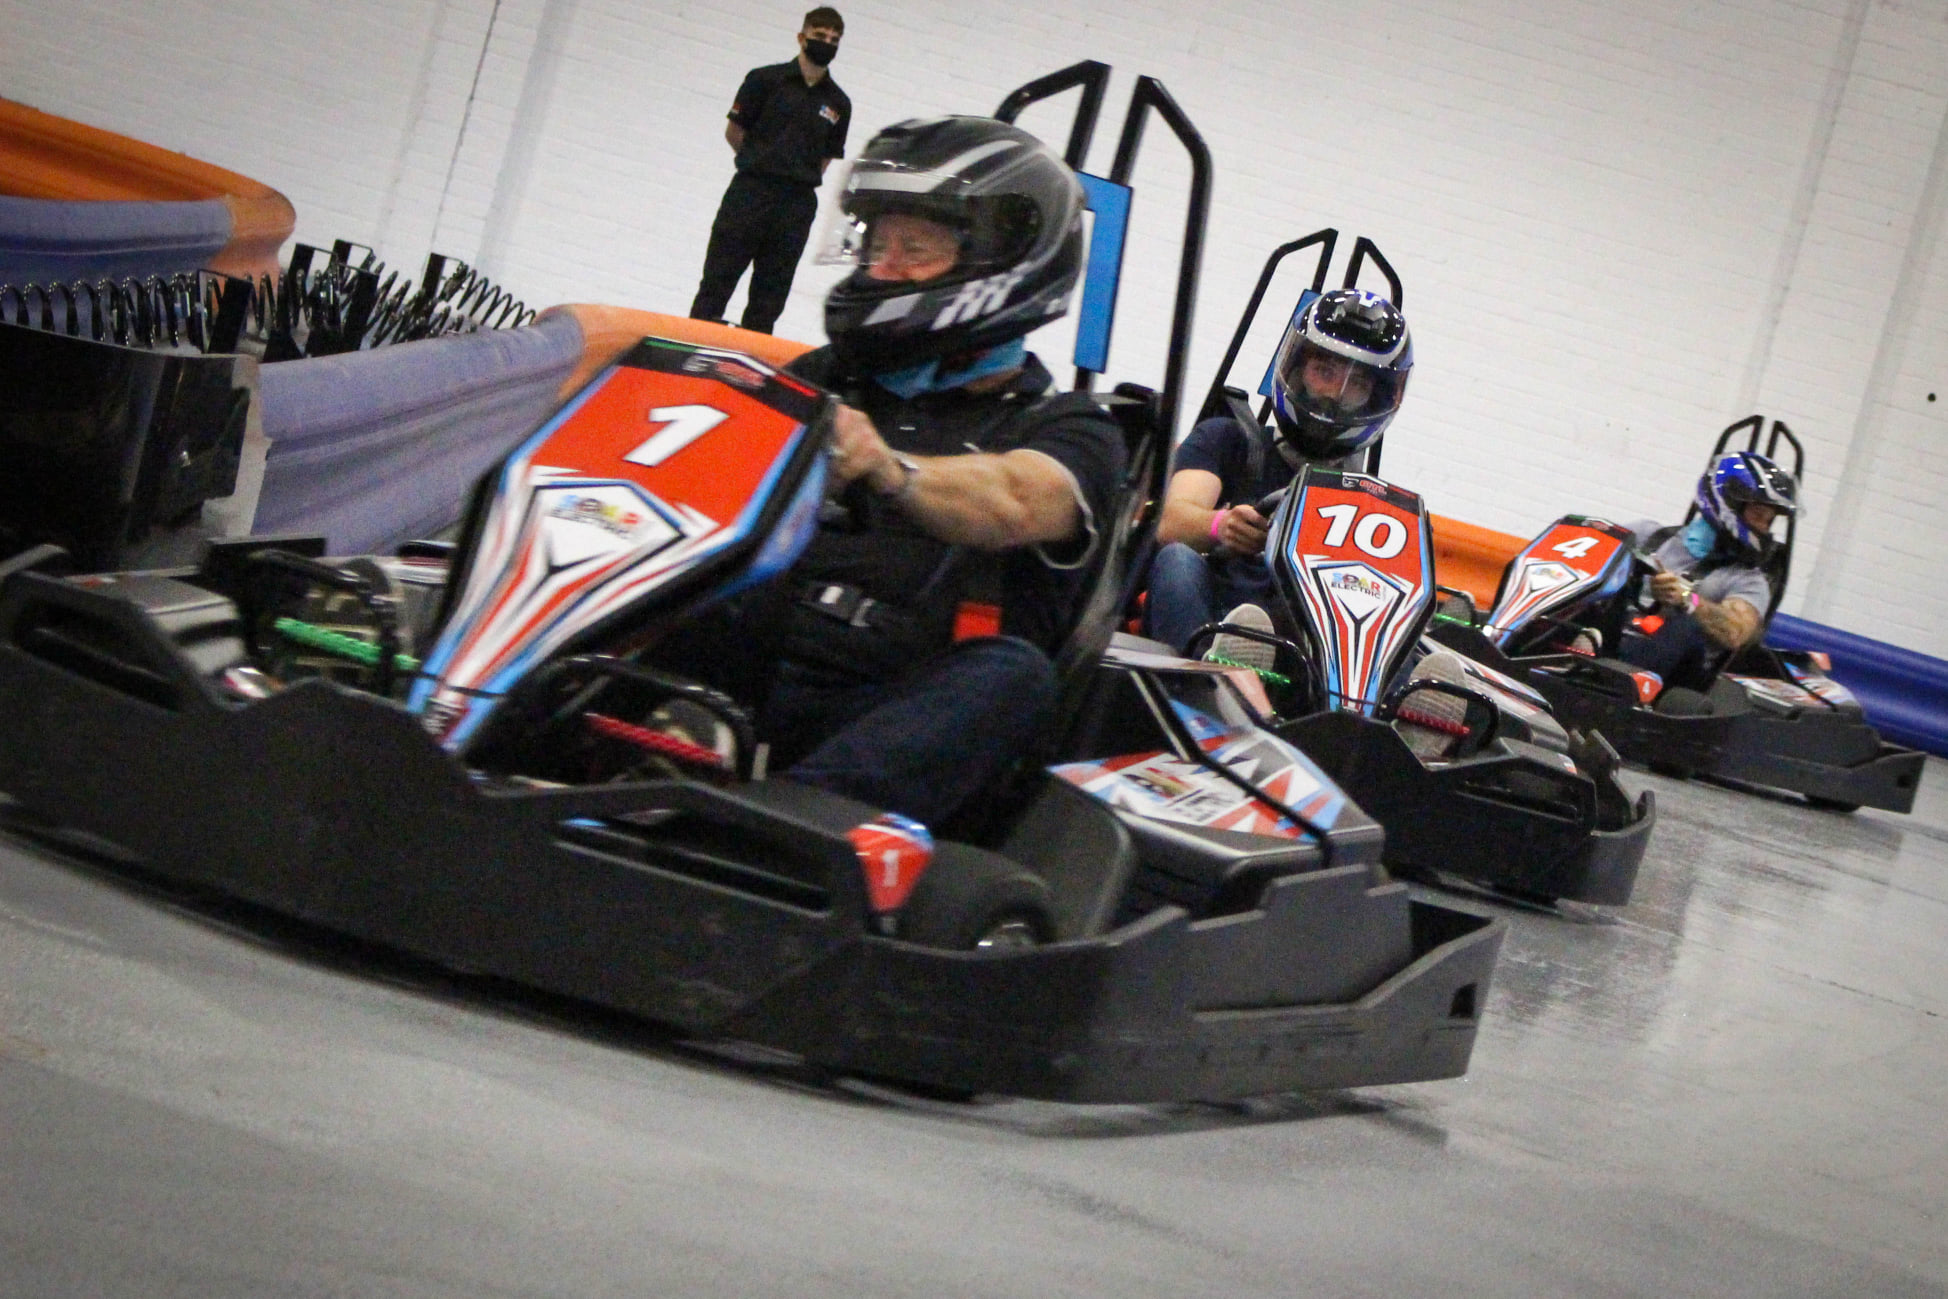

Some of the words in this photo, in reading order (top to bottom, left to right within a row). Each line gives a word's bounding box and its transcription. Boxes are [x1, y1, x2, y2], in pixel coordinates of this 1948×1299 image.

[622, 404, 730, 467] 1
[1317, 504, 1408, 559] 10
[1552, 536, 1600, 558] 4
[1331, 581, 1382, 599] ELECTRIC
[1642, 681, 1650, 695] 4
[882, 849, 900, 887] 1
